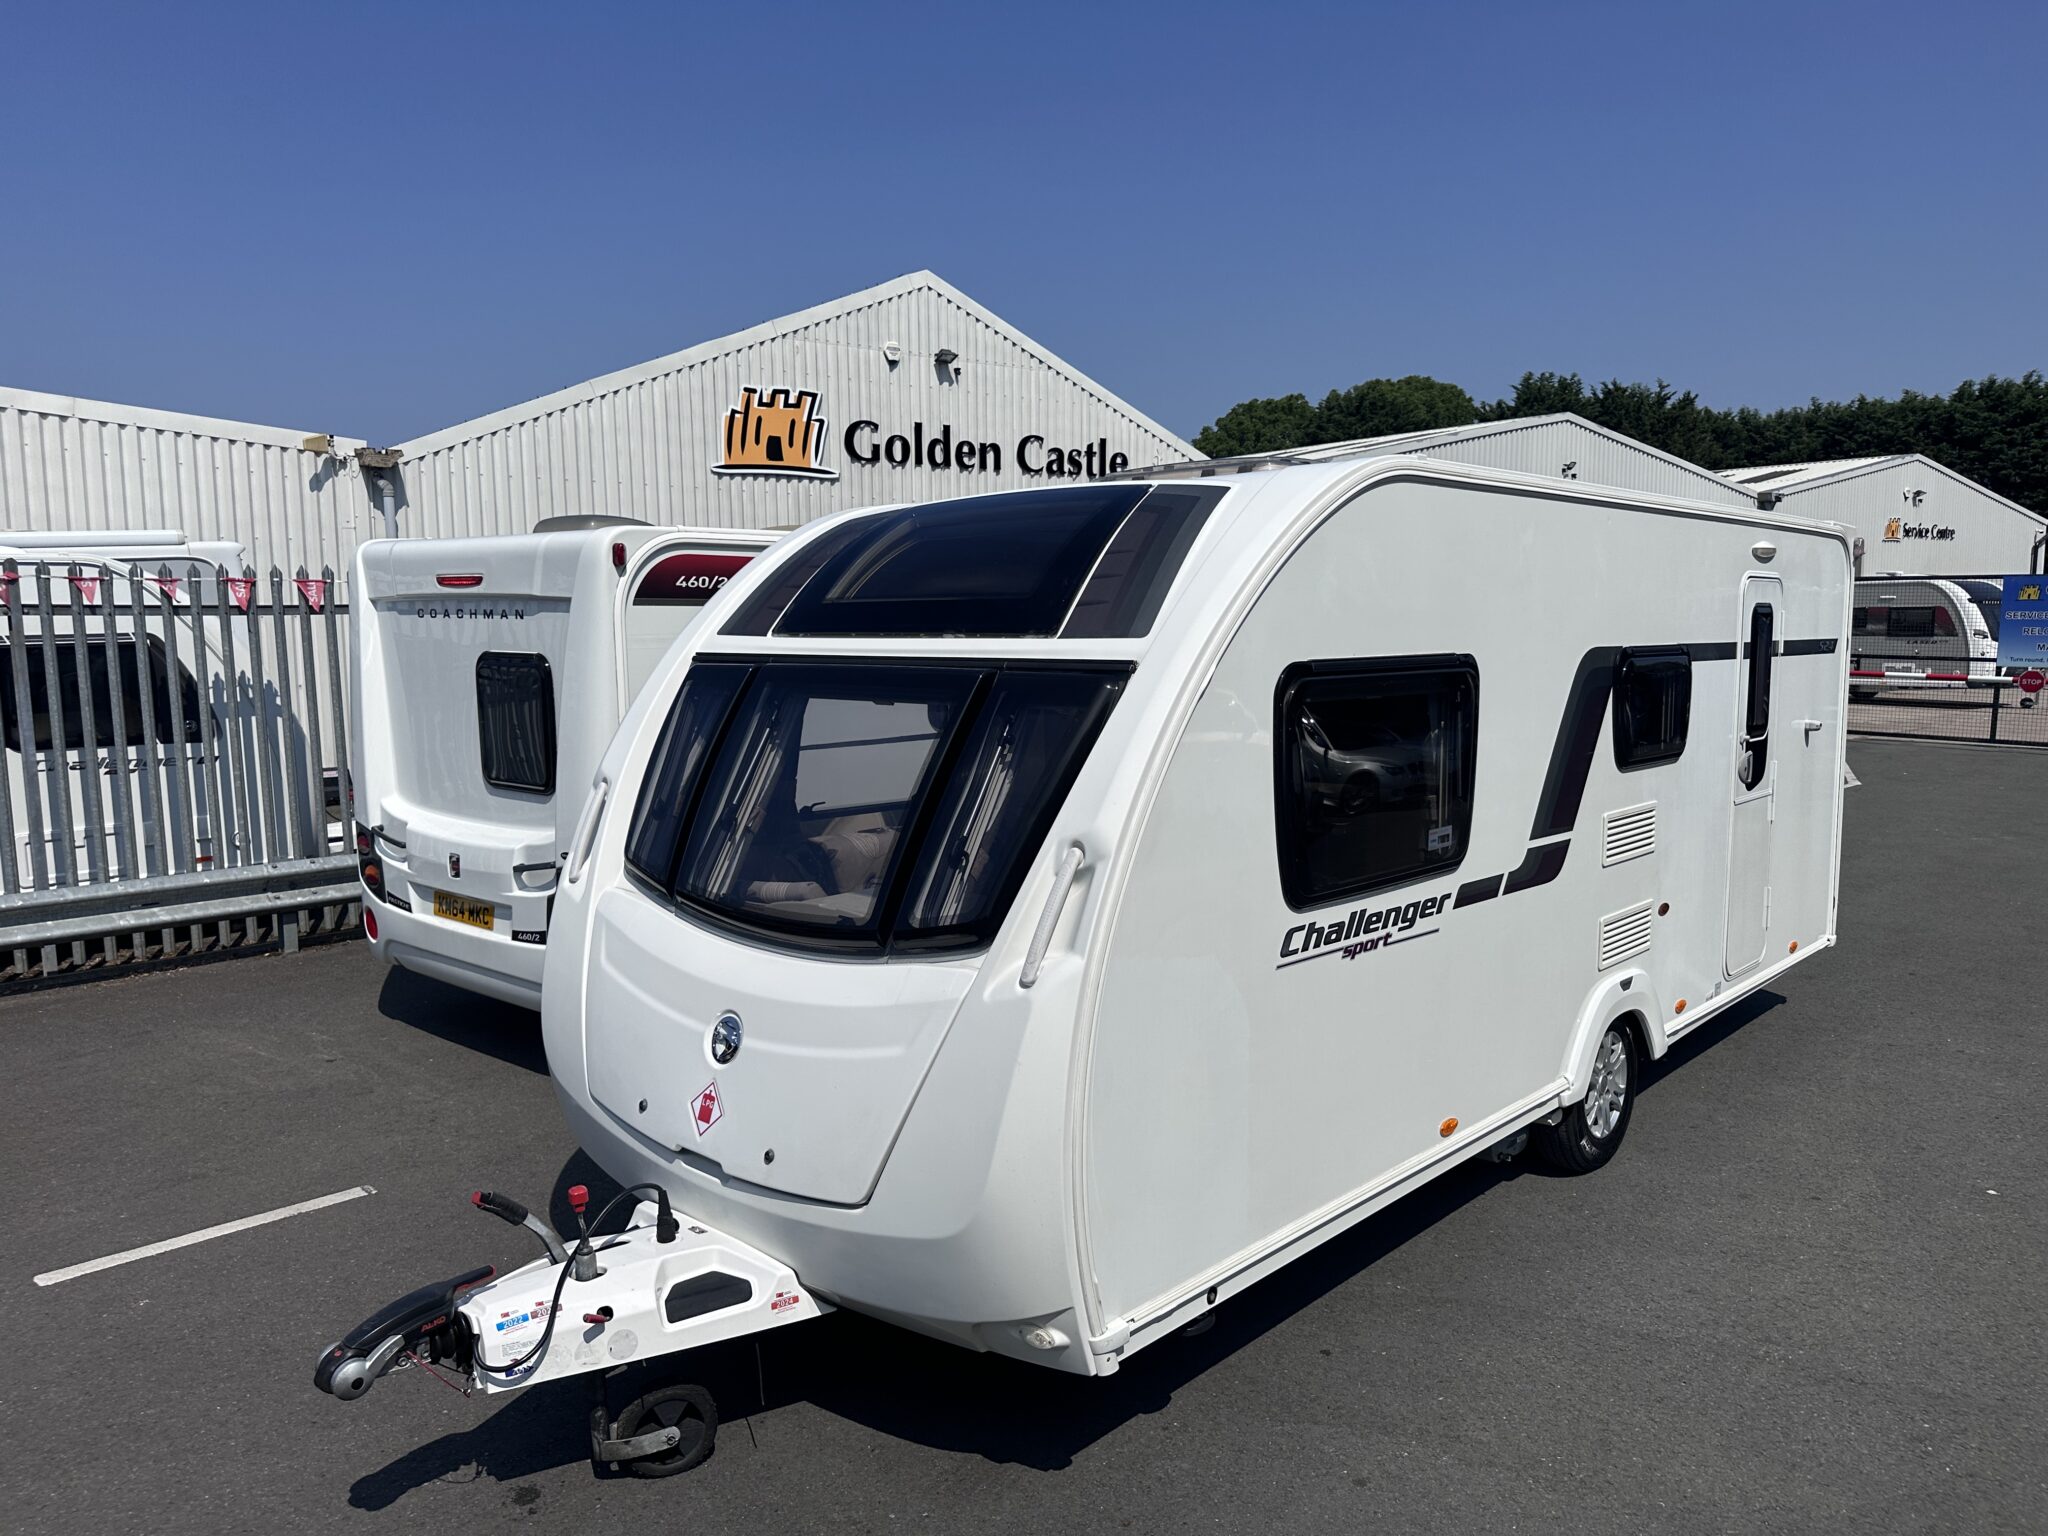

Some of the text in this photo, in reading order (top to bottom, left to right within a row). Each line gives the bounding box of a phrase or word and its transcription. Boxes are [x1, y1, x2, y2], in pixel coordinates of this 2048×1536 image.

[843, 420, 1129, 478] Golden Castle
[1902, 522, 1956, 540] Service Centre
[417, 608, 525, 620] COACHMAN
[1279, 892, 1452, 958] Challenger
[517, 931, 540, 941] 460/2
[1341, 931, 1393, 960] sport
[702, 1098, 714, 1109] LPG
[502, 1315, 523, 1329] 2022
